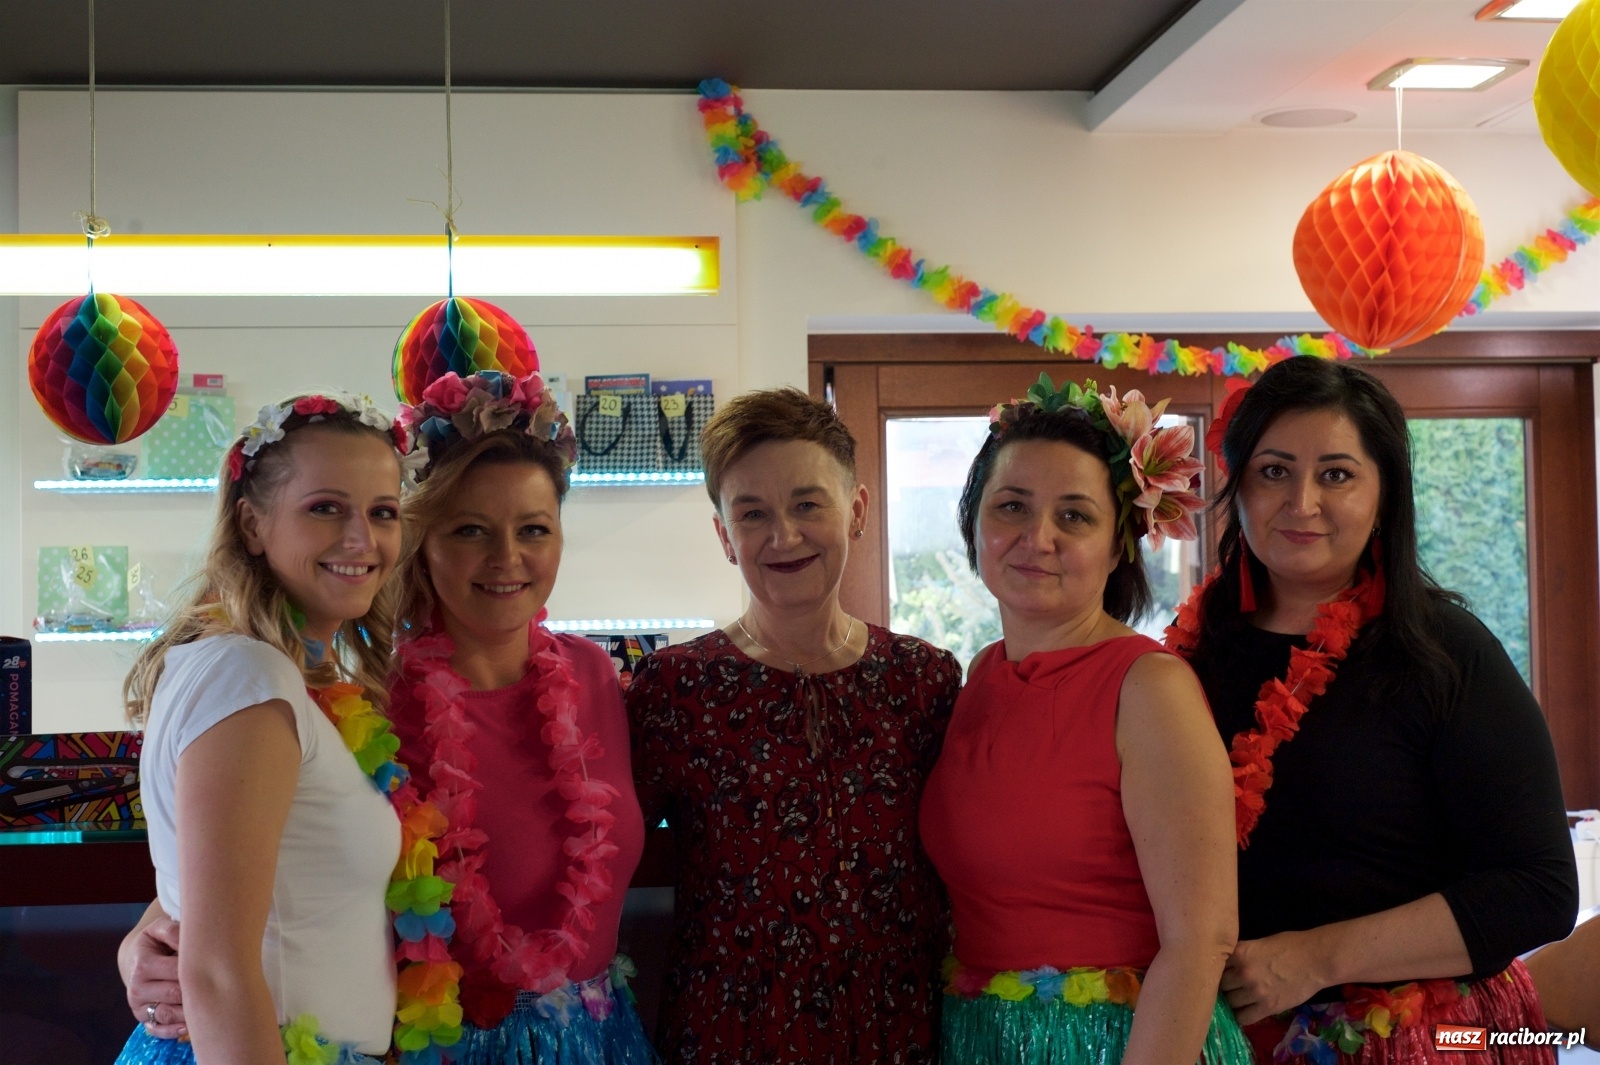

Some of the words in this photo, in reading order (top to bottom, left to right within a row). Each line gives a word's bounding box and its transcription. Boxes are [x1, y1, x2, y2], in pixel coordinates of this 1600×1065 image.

[601, 397, 617, 411] 20
[76, 566, 94, 583] 25
[3, 655, 20, 669] 28
